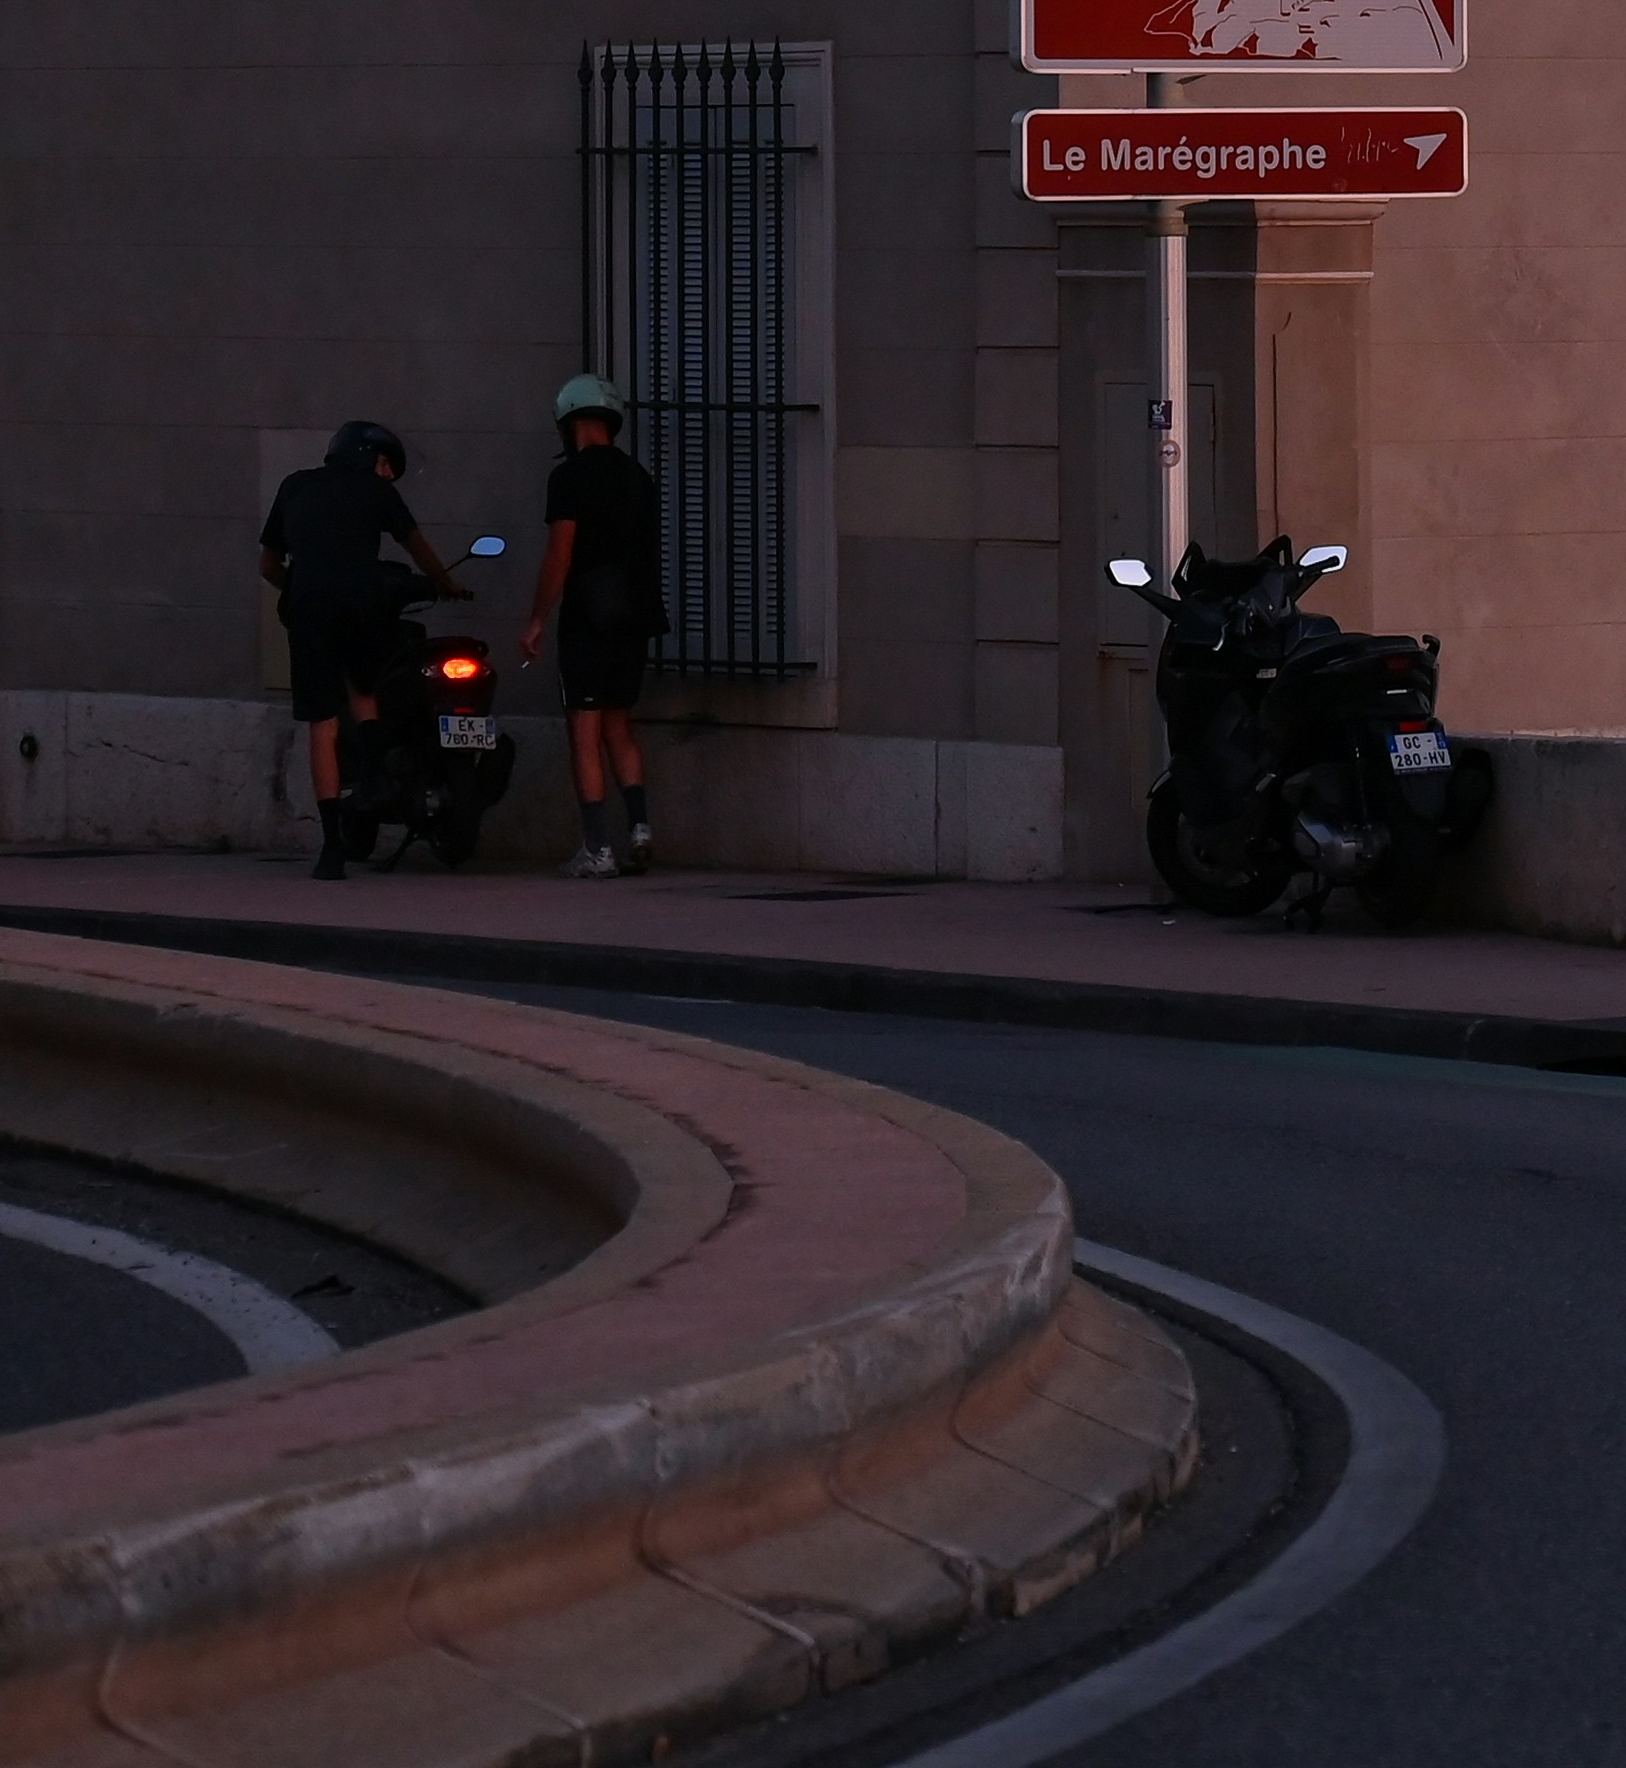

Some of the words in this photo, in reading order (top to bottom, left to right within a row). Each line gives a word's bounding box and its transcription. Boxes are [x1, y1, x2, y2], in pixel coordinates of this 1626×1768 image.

[1042, 138, 1087, 171] Le
[1100, 135, 1327, 179] Marégraphe
[1394, 751, 1446, 767] 280-HV
